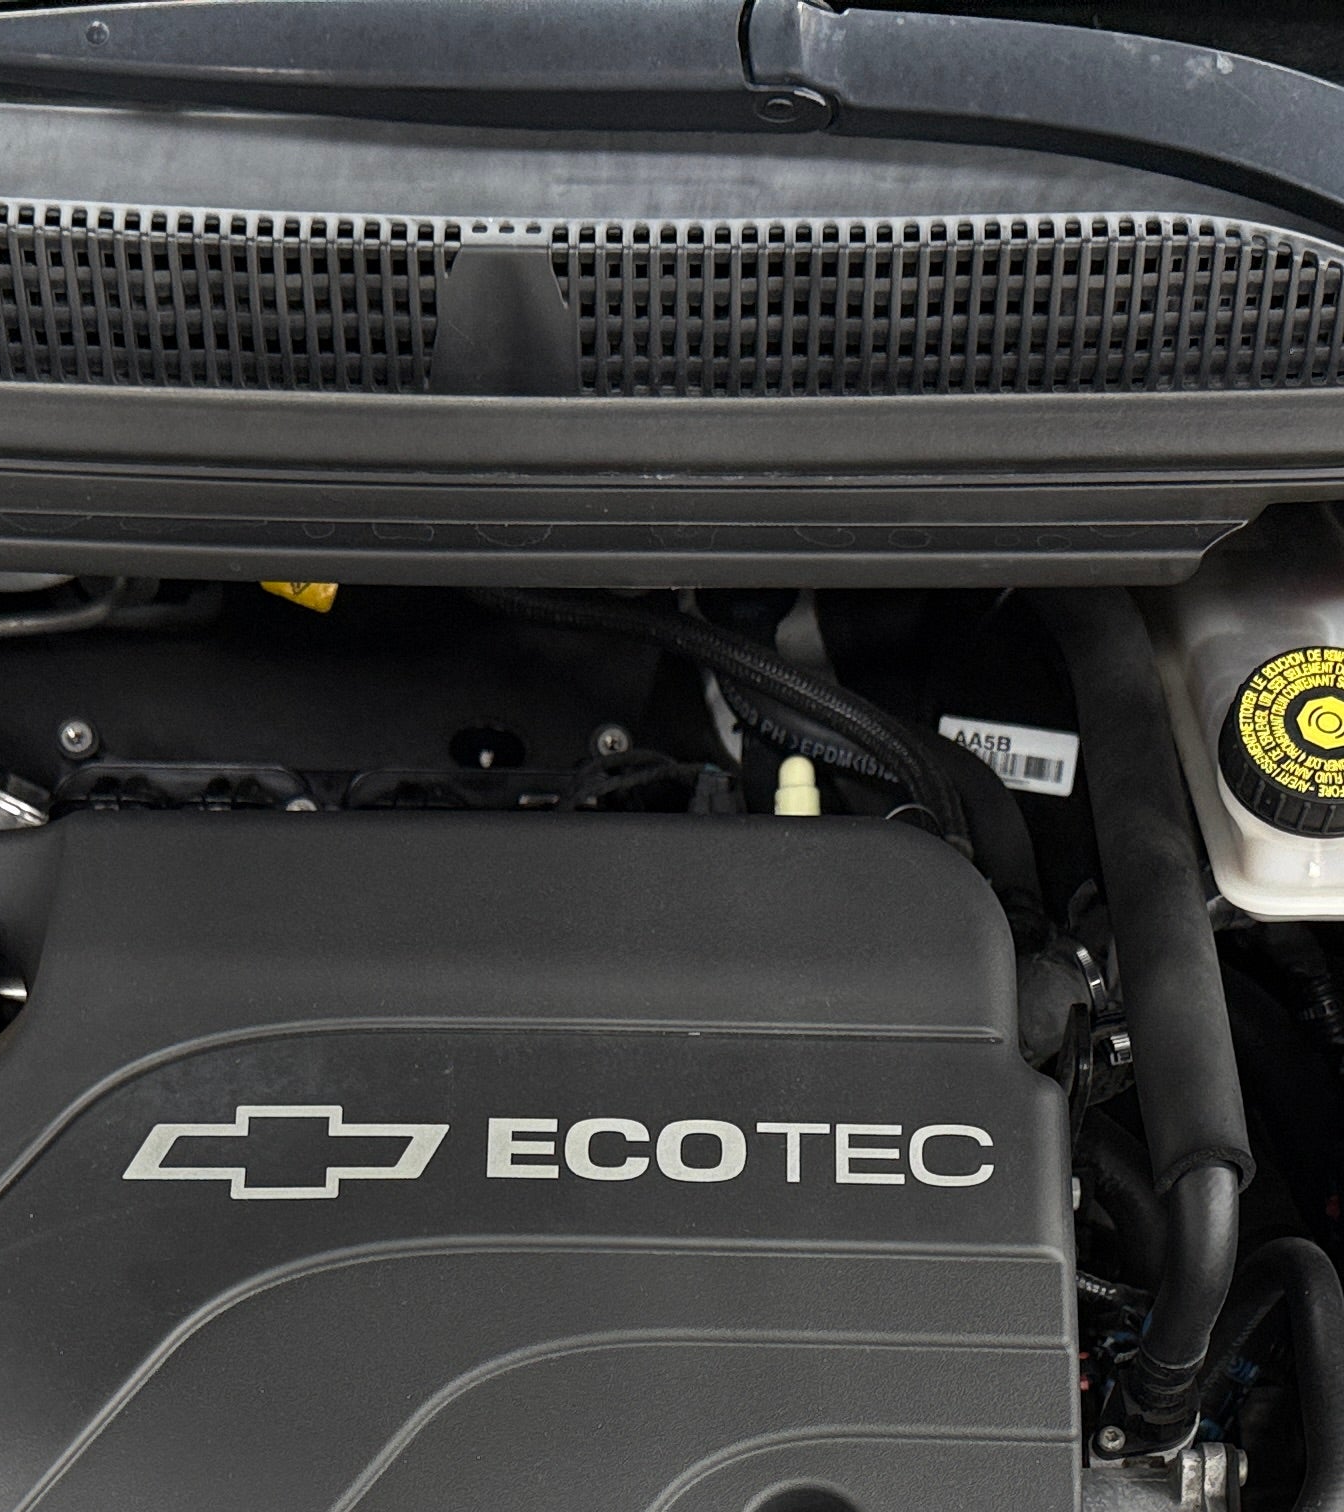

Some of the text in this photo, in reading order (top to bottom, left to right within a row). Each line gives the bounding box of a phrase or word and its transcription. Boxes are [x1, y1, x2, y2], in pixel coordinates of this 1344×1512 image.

[1261, 650, 1305, 678] BOUCHON
[1307, 649, 1321, 661] DE
[1282, 674, 1336, 699] CONTENANT
[1314, 772, 1344, 784] FLUID
[486, 1117, 995, 1188] ECOTEC
